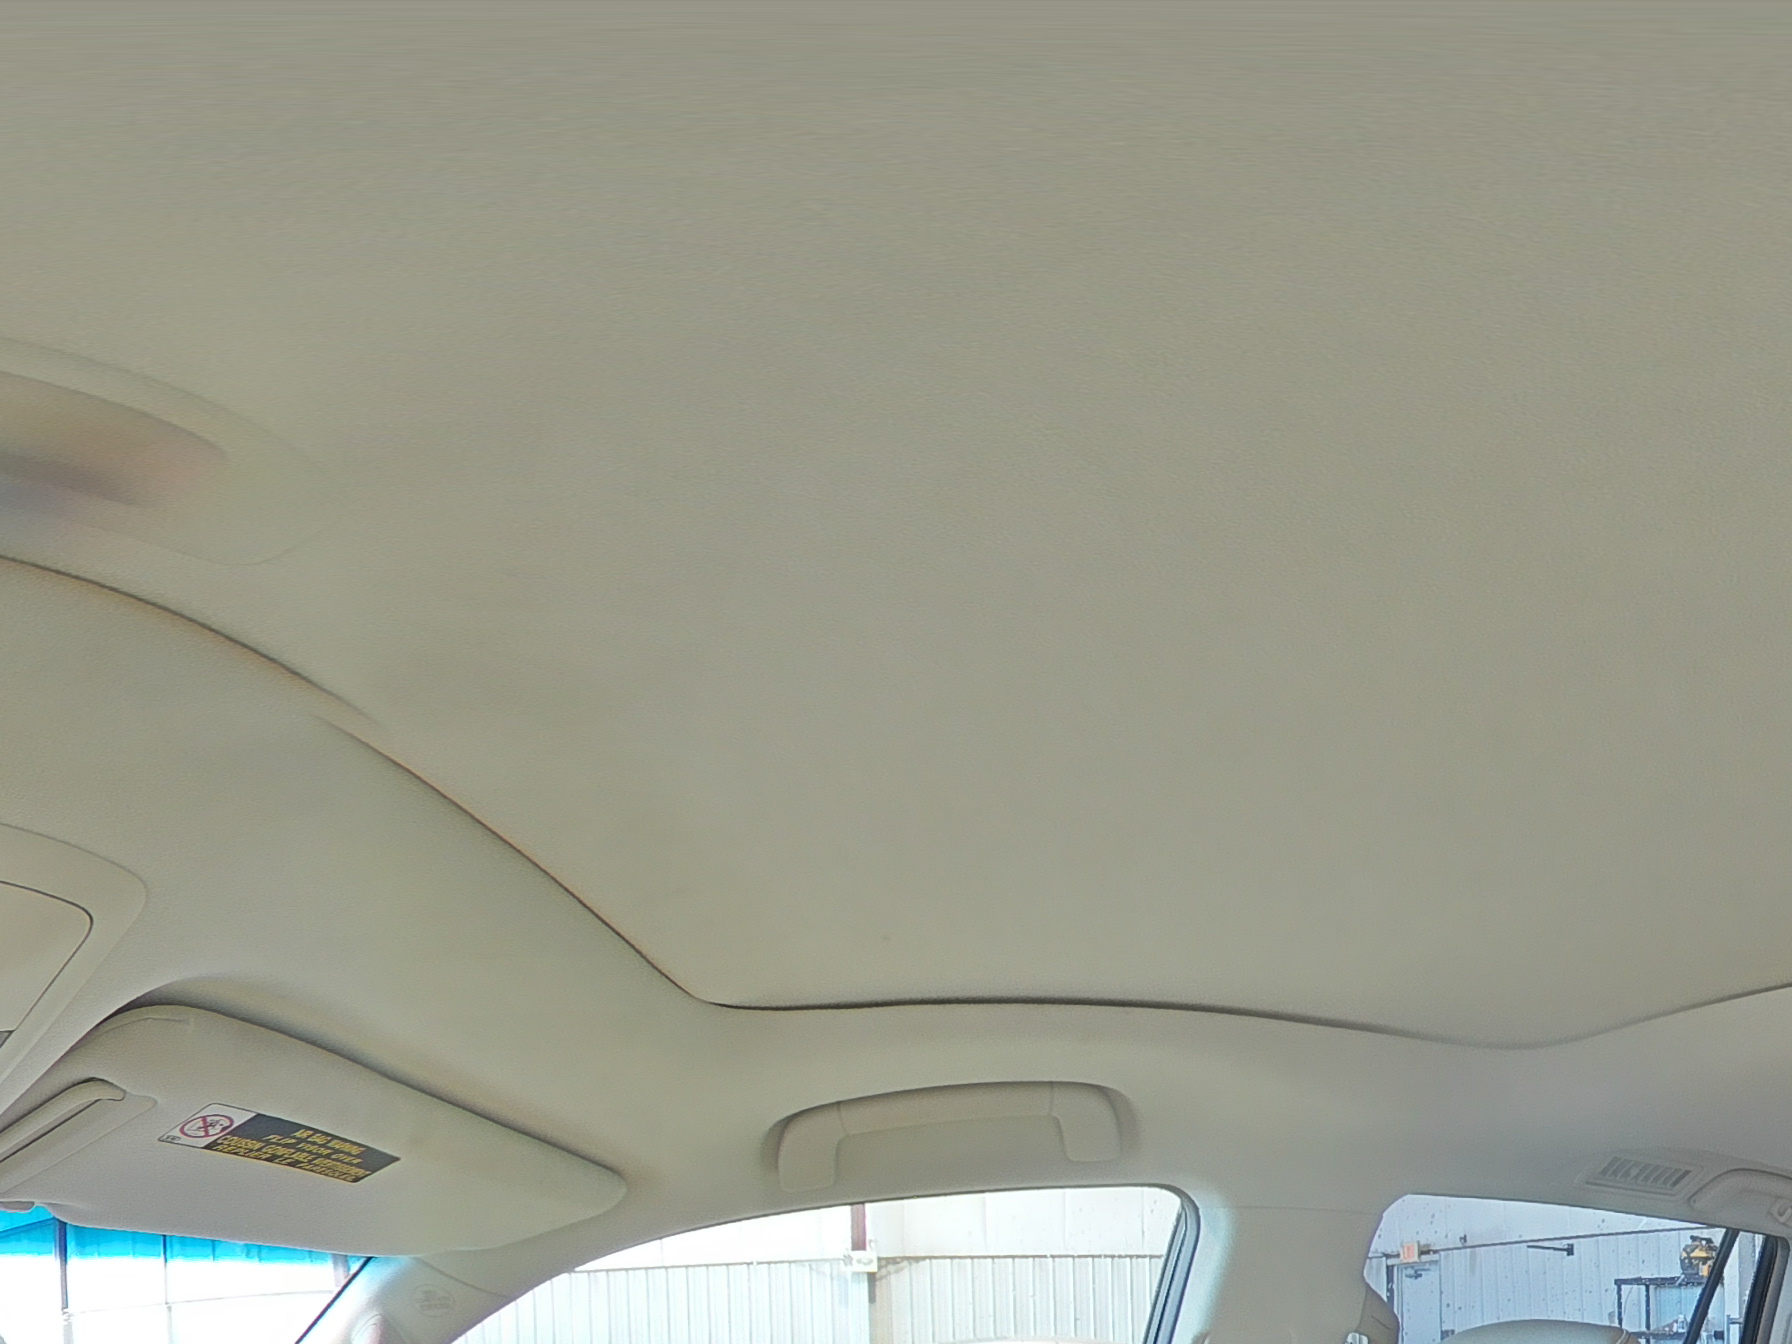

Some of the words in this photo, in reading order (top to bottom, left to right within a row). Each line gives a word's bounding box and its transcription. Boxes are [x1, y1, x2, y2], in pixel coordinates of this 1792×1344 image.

[217, 1135, 265, 1149] COUSSIN
[264, 1134, 297, 1145] FLIP
[297, 1143, 334, 1156] VISOR
[331, 1153, 364, 1164] OVER
[215, 1145, 272, 1160] REPLIER
[273, 1157, 291, 1165] LE
